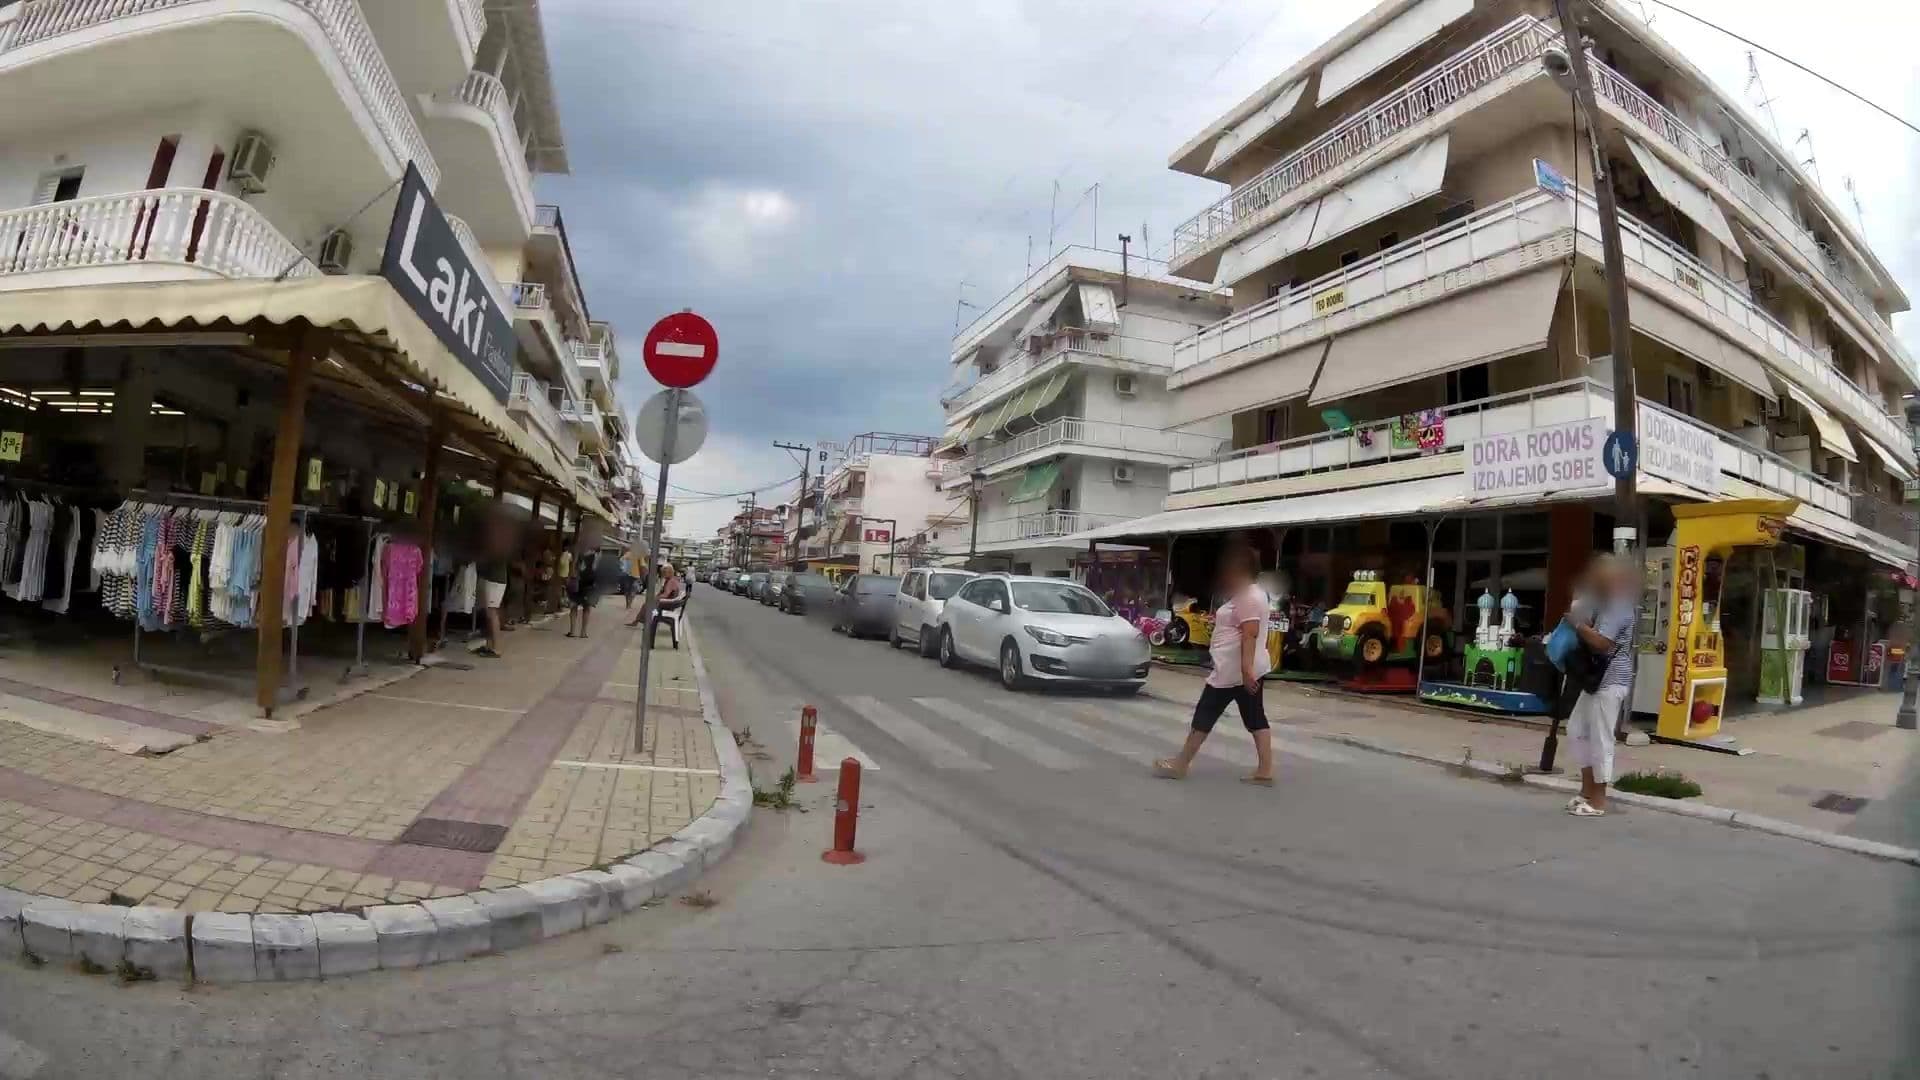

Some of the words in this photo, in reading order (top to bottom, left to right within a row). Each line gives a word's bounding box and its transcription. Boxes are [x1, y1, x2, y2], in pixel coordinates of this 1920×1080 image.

[399, 189, 488, 356] Laki
[1473, 436, 1520, 466] DORA
[1527, 424, 1594, 459] ROOMS
[1646, 413, 1677, 447] DORA
[1680, 426, 1714, 460] ROOMS
[1473, 464, 1547, 492] IZDAJEMO
[1552, 457, 1595, 482] SOBE
